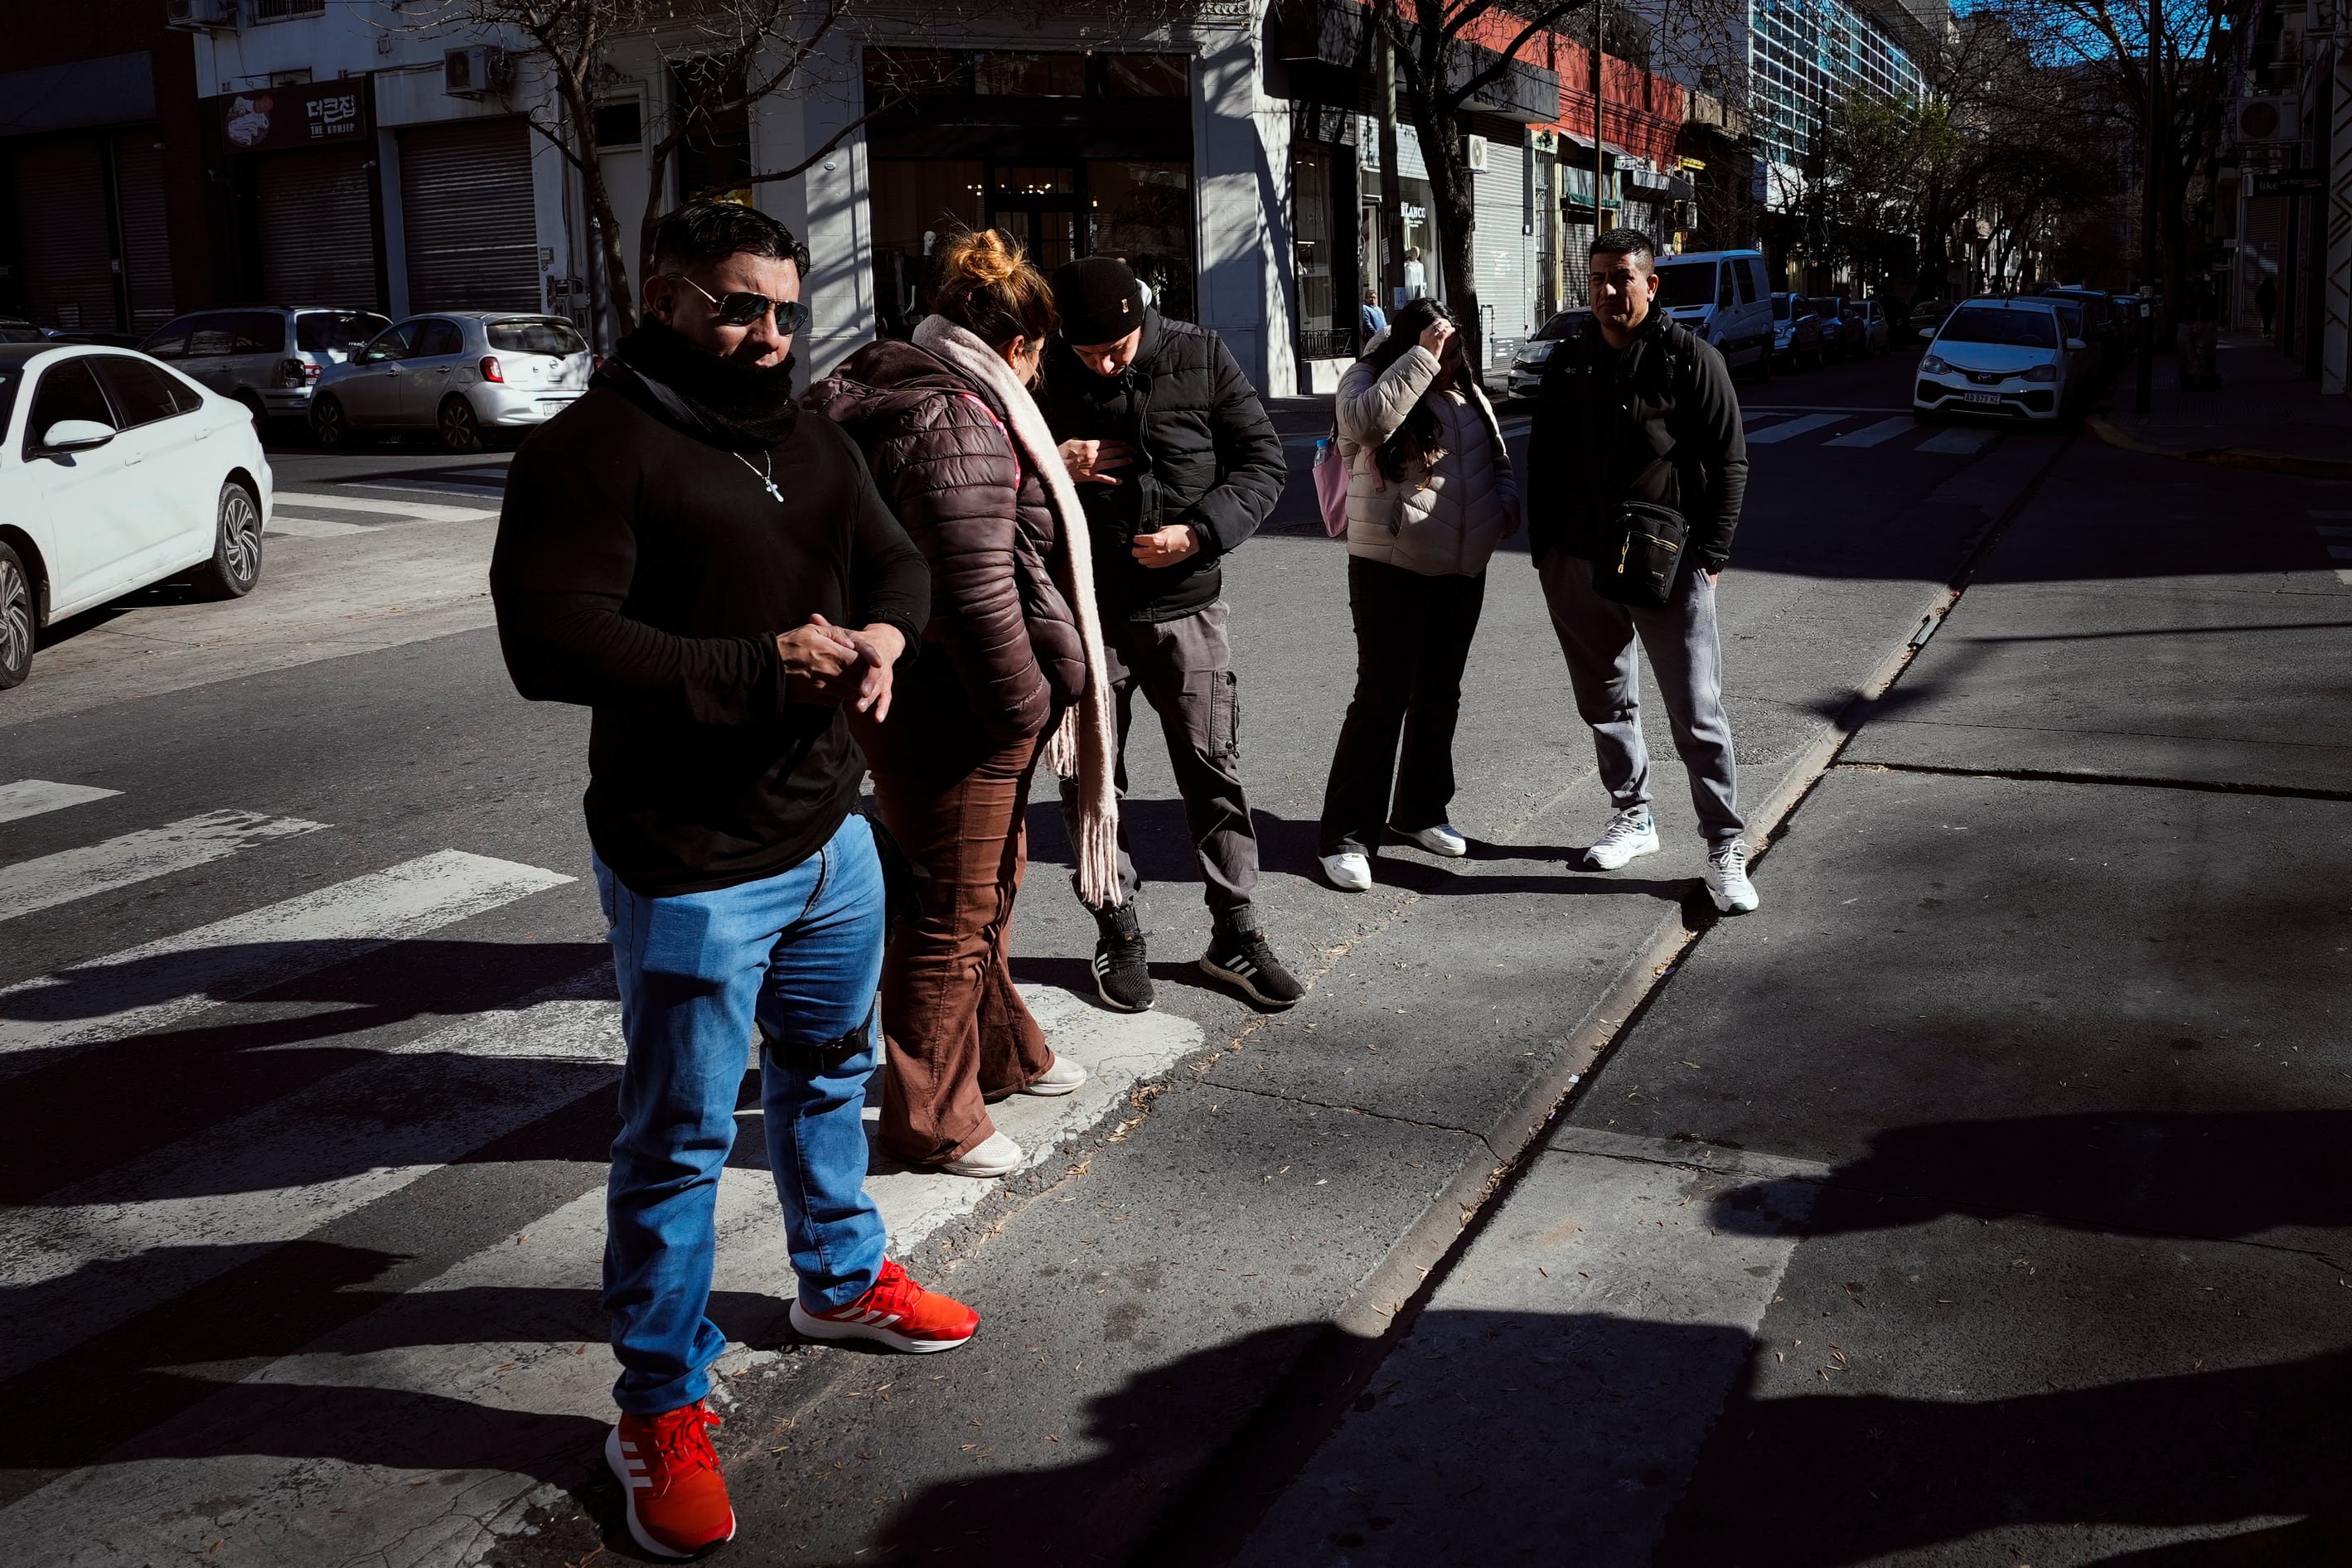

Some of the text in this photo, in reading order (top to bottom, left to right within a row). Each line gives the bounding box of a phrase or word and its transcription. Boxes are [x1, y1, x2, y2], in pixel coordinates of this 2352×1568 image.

[307, 94, 356, 123] 더큰집
[311, 125, 323, 135] THE
[2259, 180, 2278, 191] like
